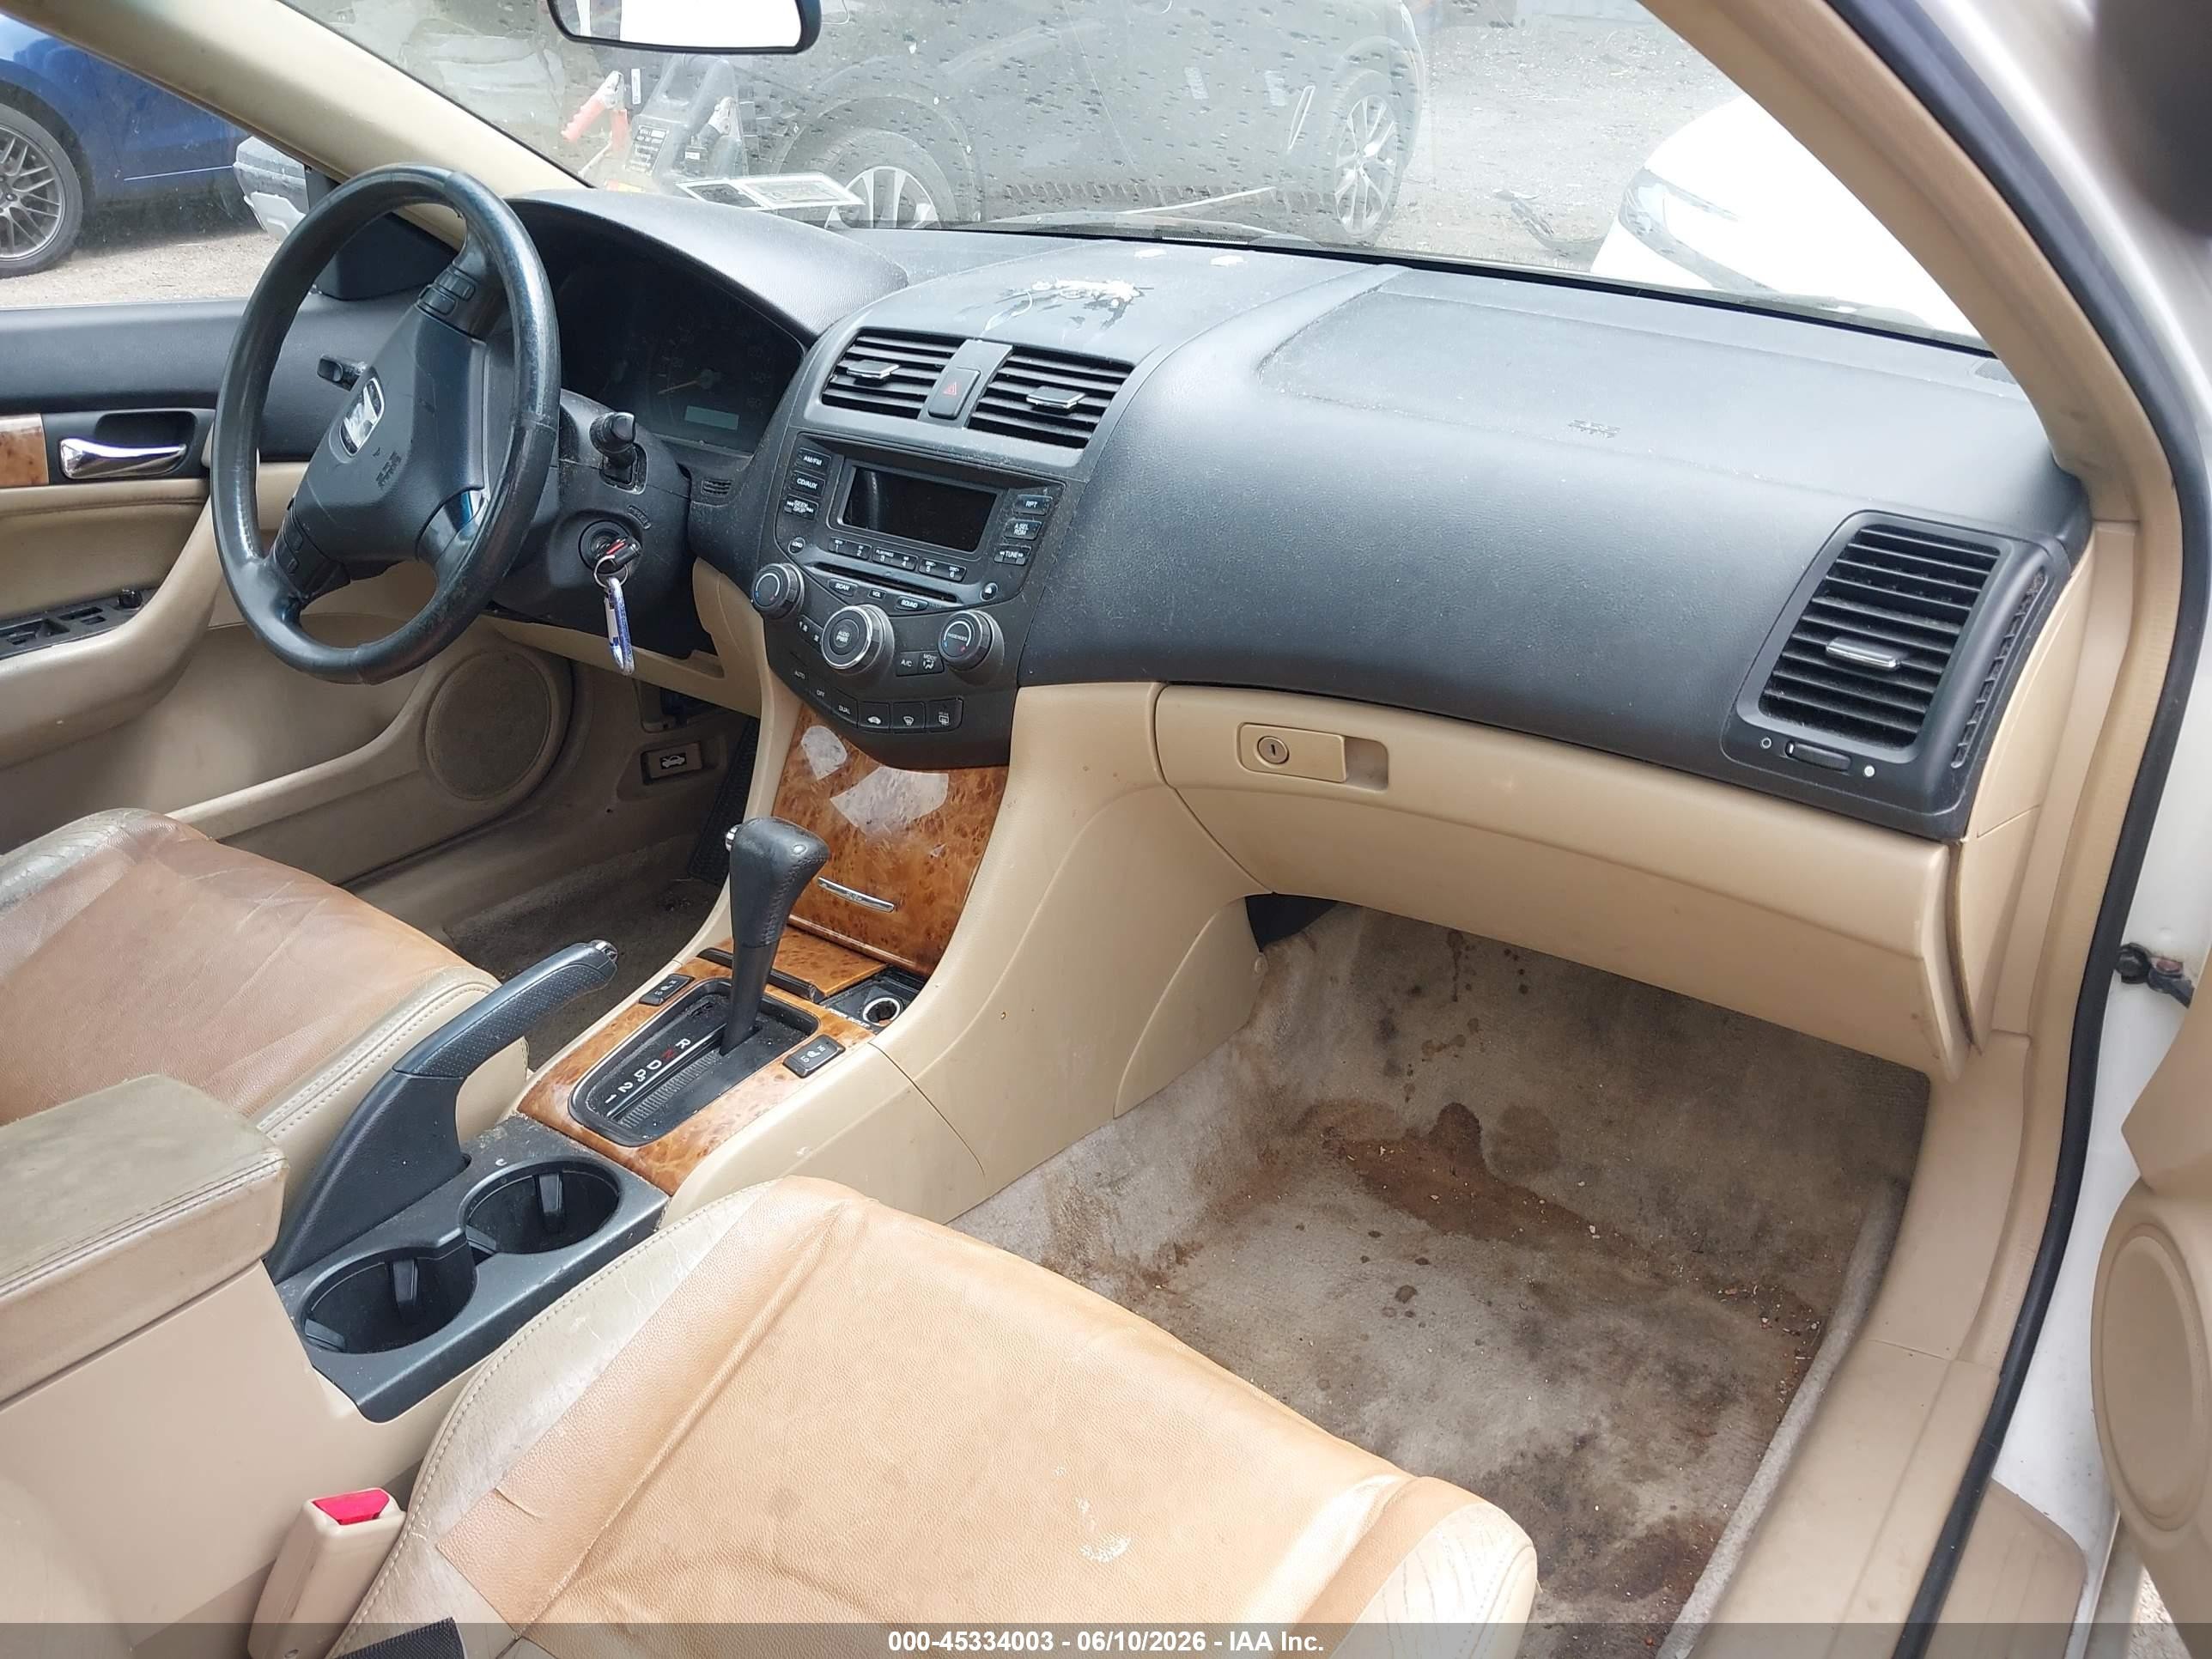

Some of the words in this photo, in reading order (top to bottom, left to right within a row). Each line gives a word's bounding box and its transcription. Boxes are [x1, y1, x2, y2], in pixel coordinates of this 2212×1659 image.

[803, 455, 823, 465] AM/FM
[797, 477, 817, 489] CD/AUX
[835, 583, 851, 592] SCAN
[902, 600, 919, 609] SOUND
[836, 635, 848, 643] PWR
[794, 671, 805, 679] AUTO
[838, 705, 851, 715] DUAL
[675, 1038, 691, 1049] R
[647, 1060, 662, 1070] D
[617, 1082, 634, 1093] 2
[605, 1094, 617, 1104] 1
